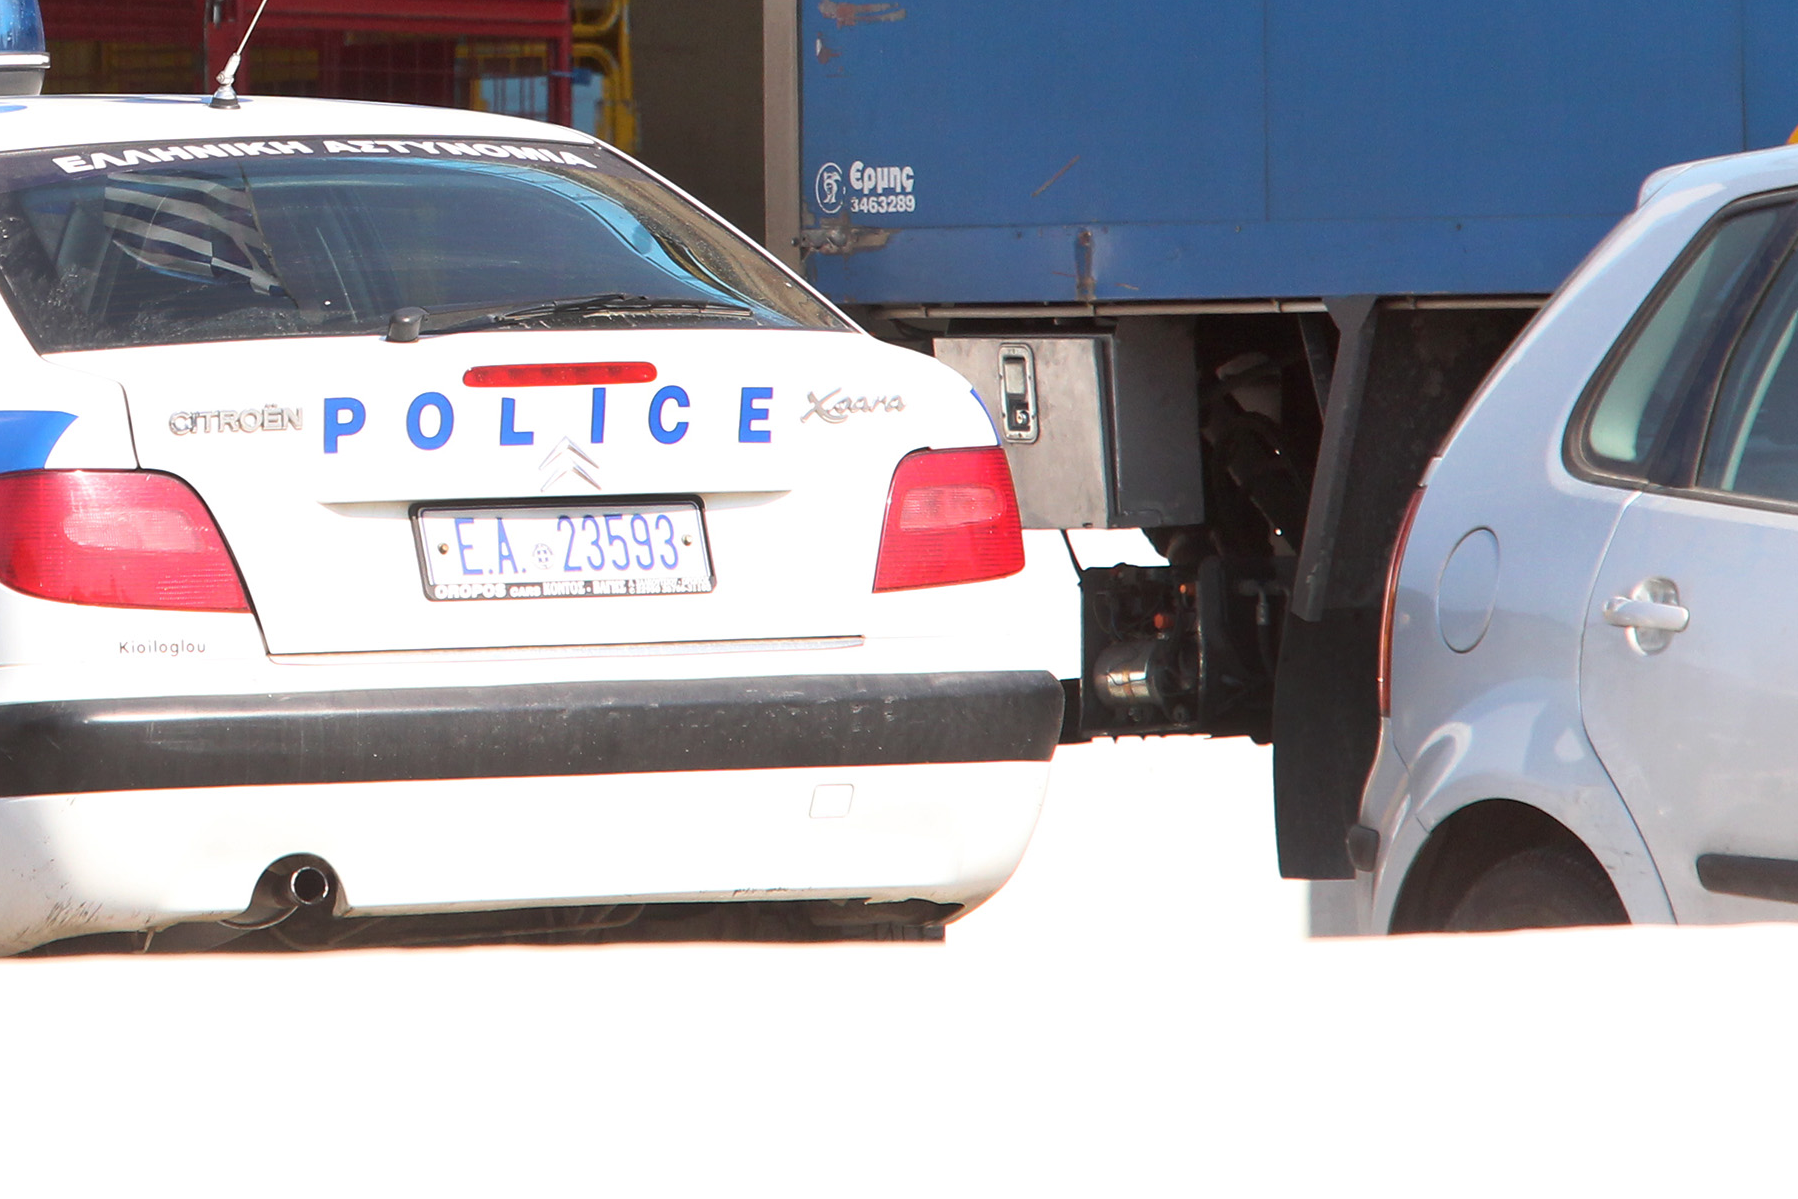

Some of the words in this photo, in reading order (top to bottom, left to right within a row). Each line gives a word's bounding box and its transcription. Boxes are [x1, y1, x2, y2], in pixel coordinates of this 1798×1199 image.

[52, 140, 315, 174] ΕΛΛΗΝΙΚΗ
[322, 140, 598, 169] ΑΣΤΥΝΟΜΙΑ
[850, 195, 916, 213] 3463289
[323, 386, 774, 455] POLICE
[556, 514, 679, 572] 23593
